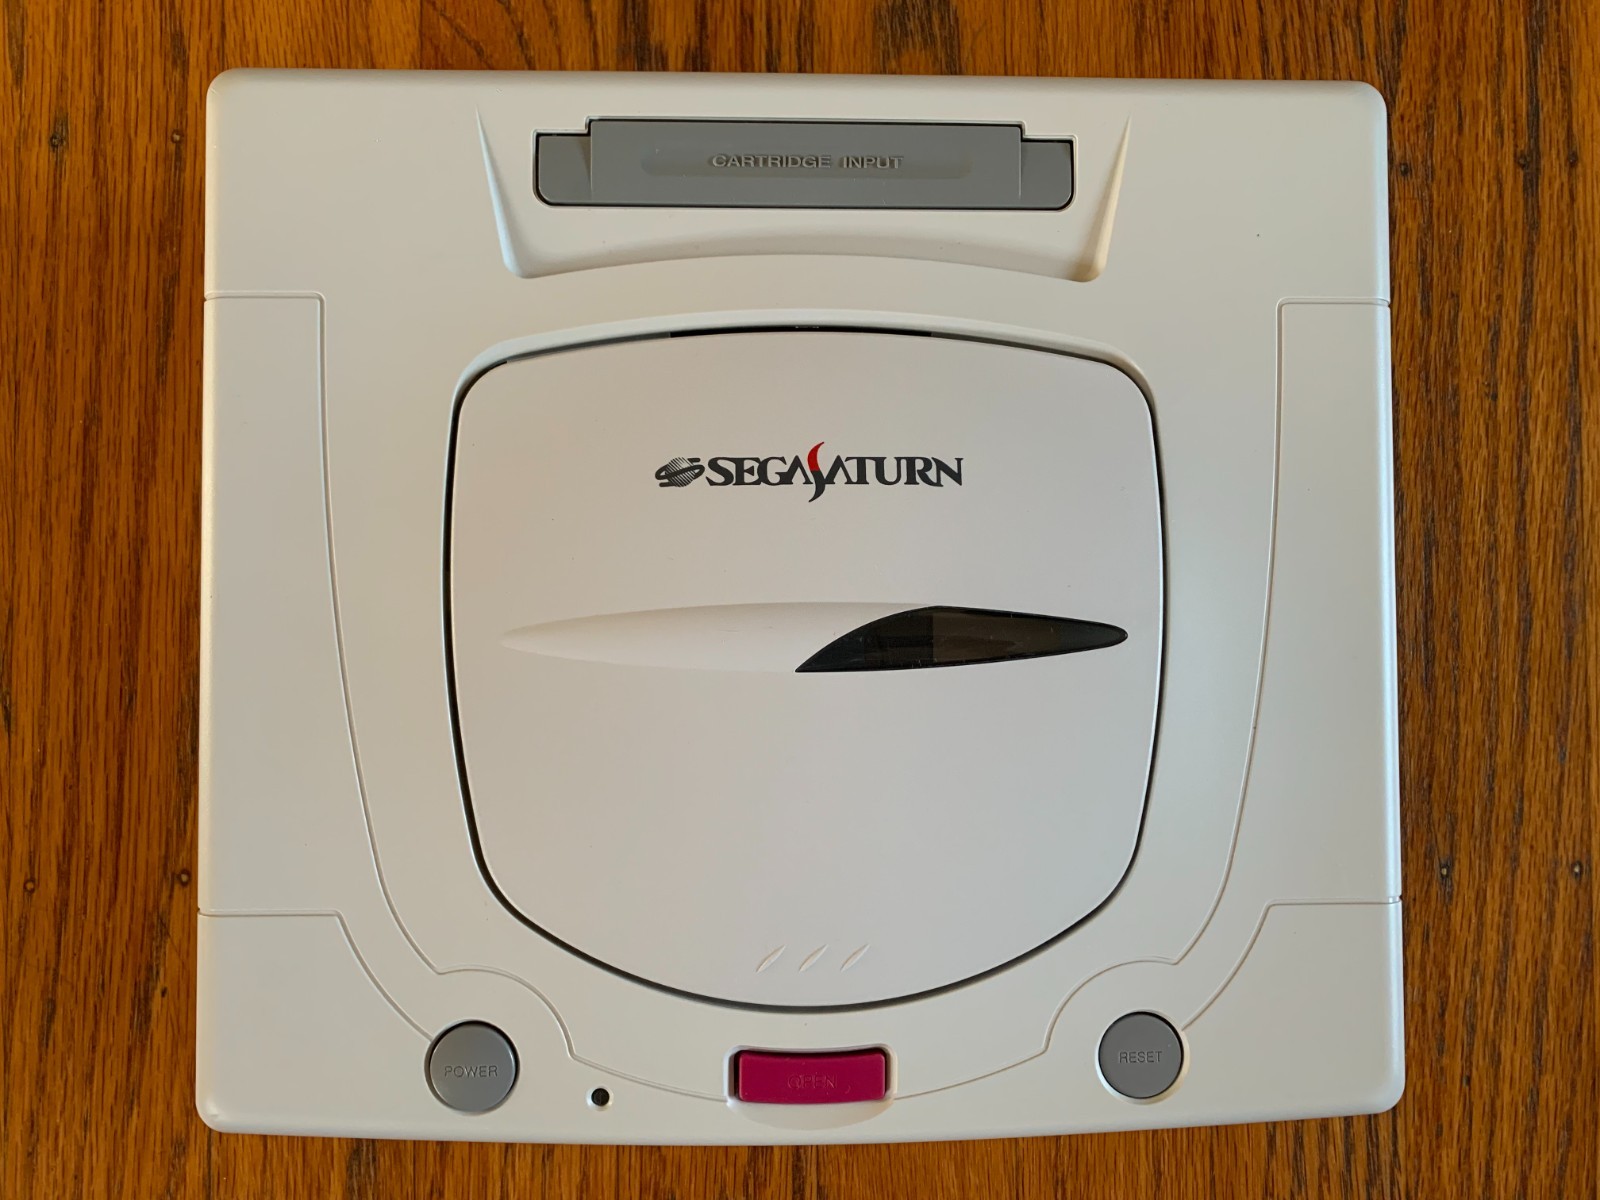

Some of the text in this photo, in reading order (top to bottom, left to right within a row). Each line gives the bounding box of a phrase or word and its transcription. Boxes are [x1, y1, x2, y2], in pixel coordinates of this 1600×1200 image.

[710, 154, 904, 170] CARTRIDGE INPUT
[1119, 1050, 1163, 1064] RESET
[444, 1065, 498, 1078] POWER
[787, 1073, 837, 1089] OPEN
